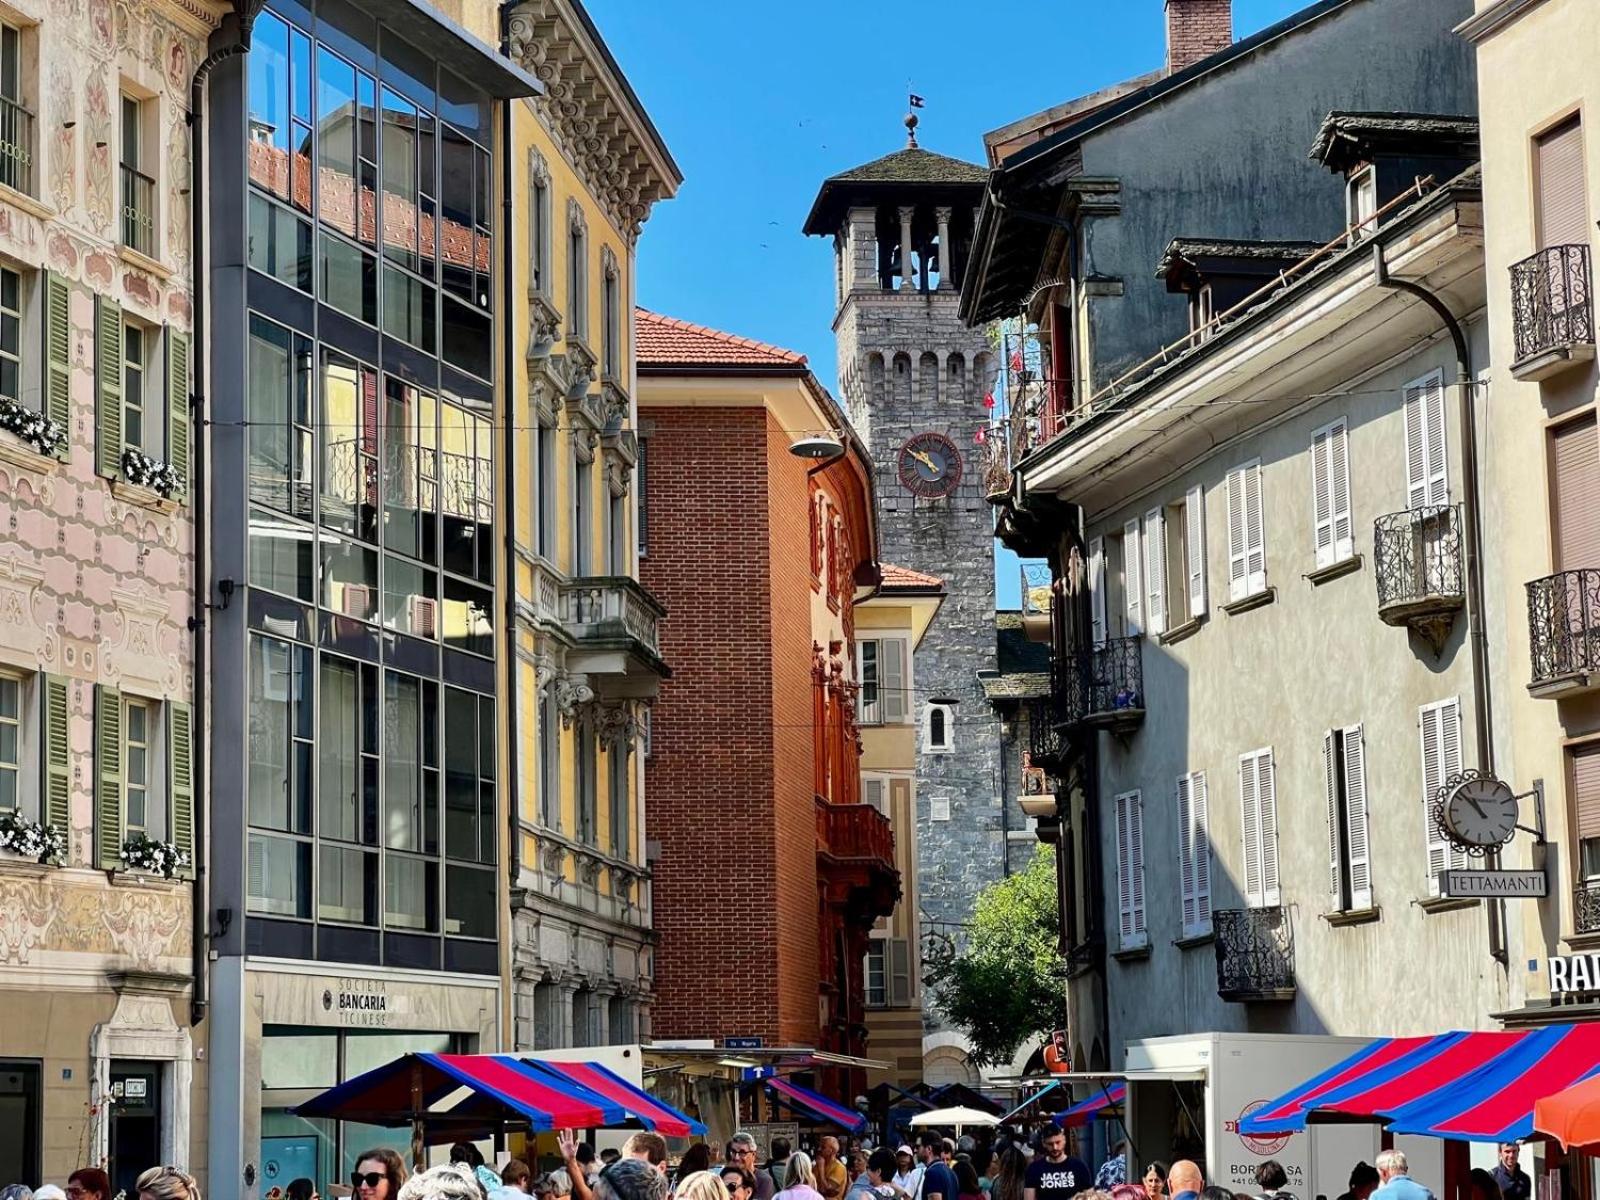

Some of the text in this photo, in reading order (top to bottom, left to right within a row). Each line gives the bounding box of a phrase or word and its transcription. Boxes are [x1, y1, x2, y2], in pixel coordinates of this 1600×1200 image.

[1450, 876, 1541, 891] TETTAMANTI
[339, 993, 386, 1010] BANCARIA
[339, 1012, 386, 1025] TICINESE
[1286, 1165, 1303, 1175] SA
[1040, 1171, 1075, 1181] JACK&
[1040, 1180, 1075, 1189] JONES
